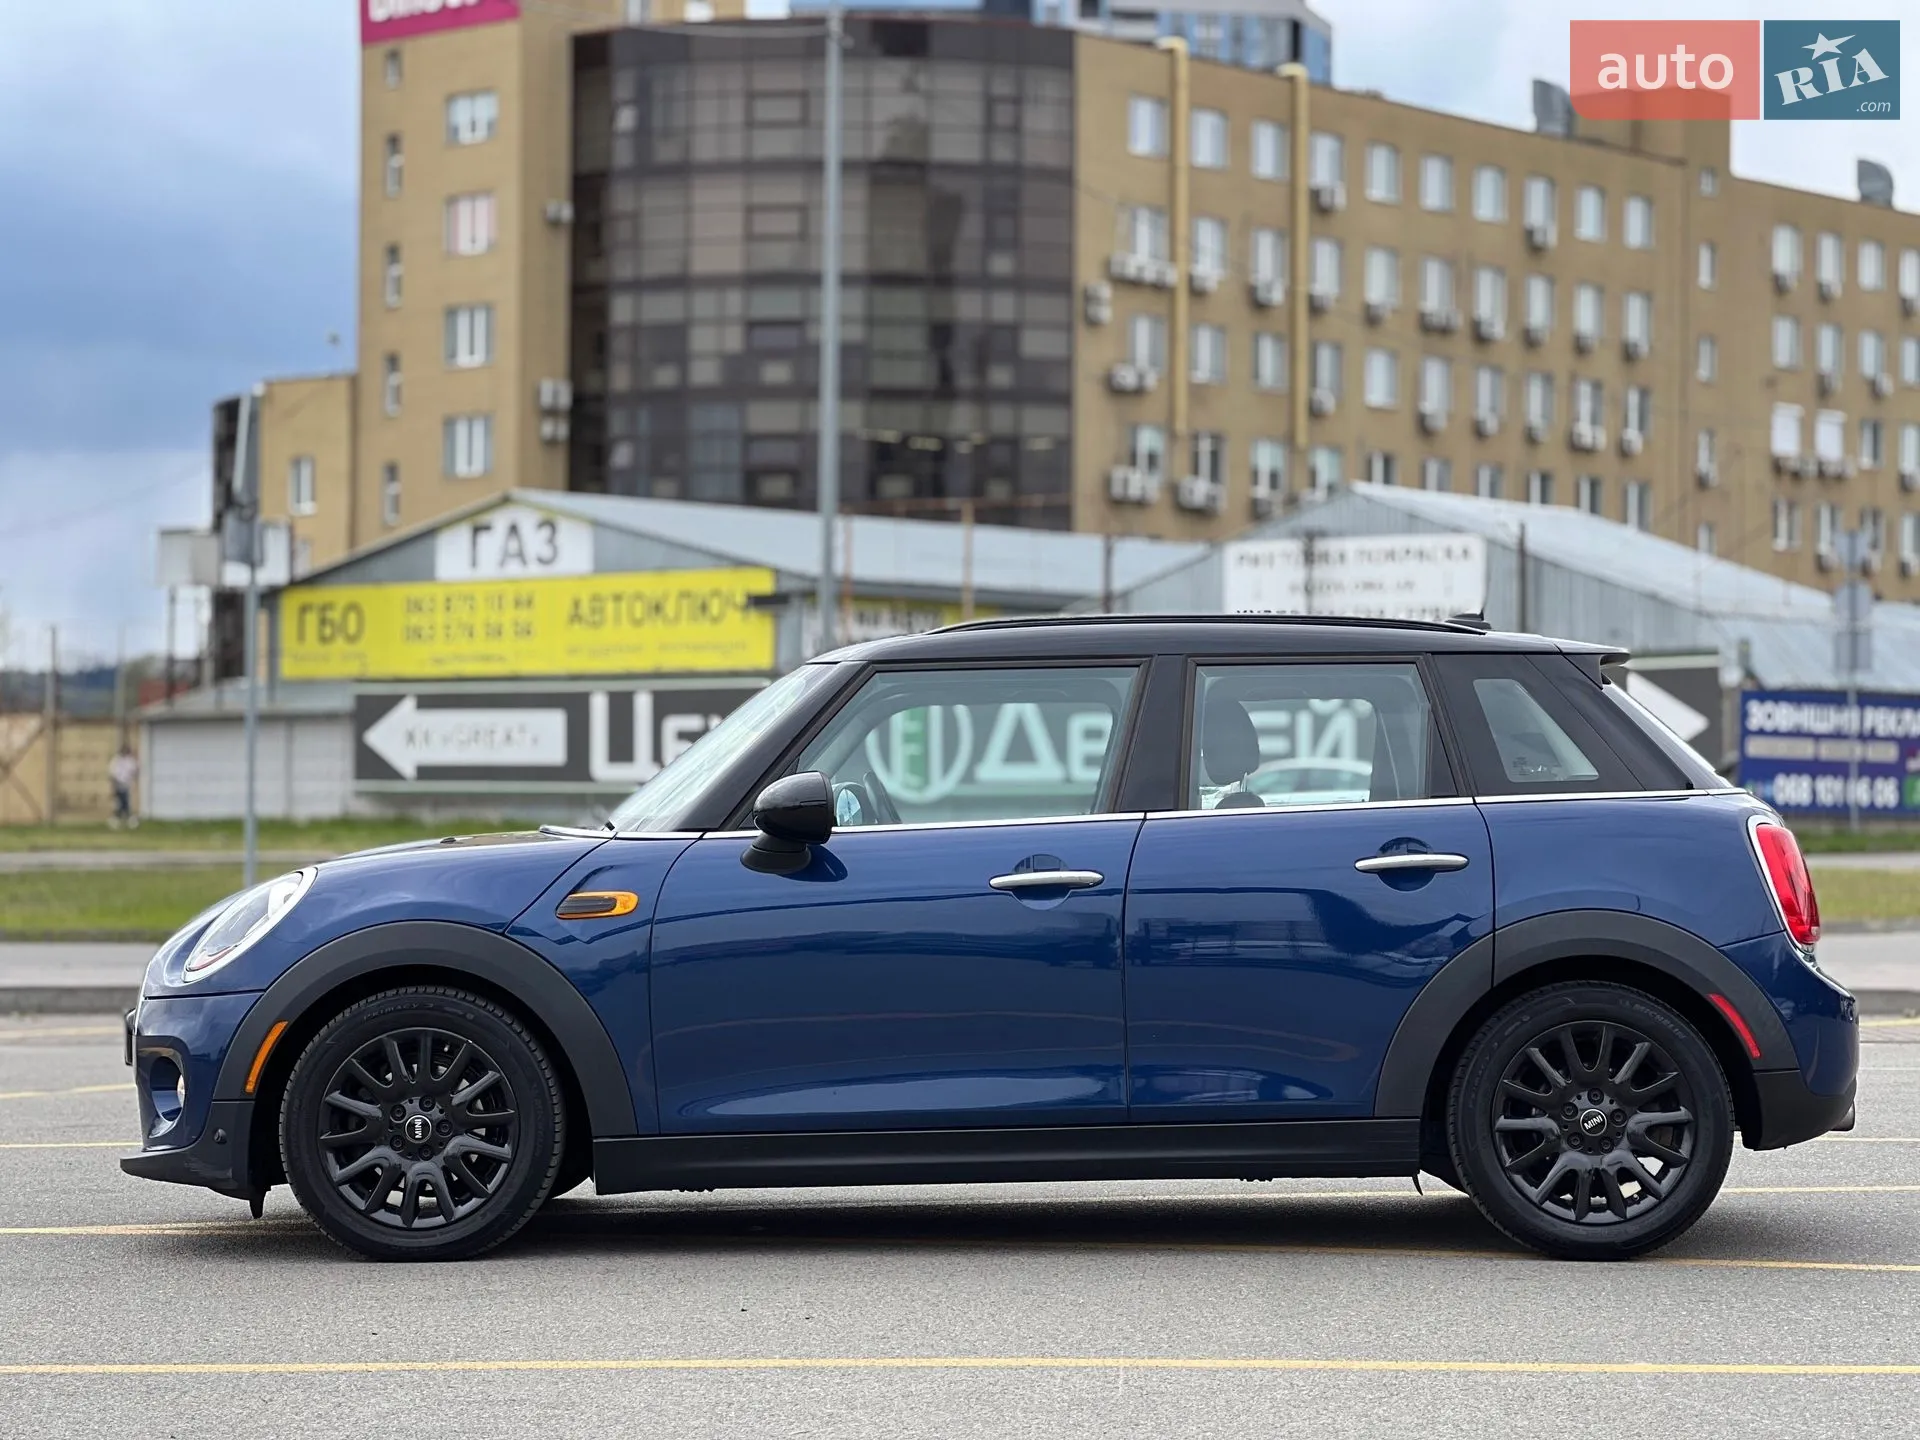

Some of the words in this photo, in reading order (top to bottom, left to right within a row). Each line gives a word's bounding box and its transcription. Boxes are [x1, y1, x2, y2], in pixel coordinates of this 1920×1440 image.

[471, 519, 559, 570] ГАЗ
[296, 601, 367, 646] ГБО
[413, 1117, 424, 1140] MINI
[1582, 1114, 1604, 1131] MINI
